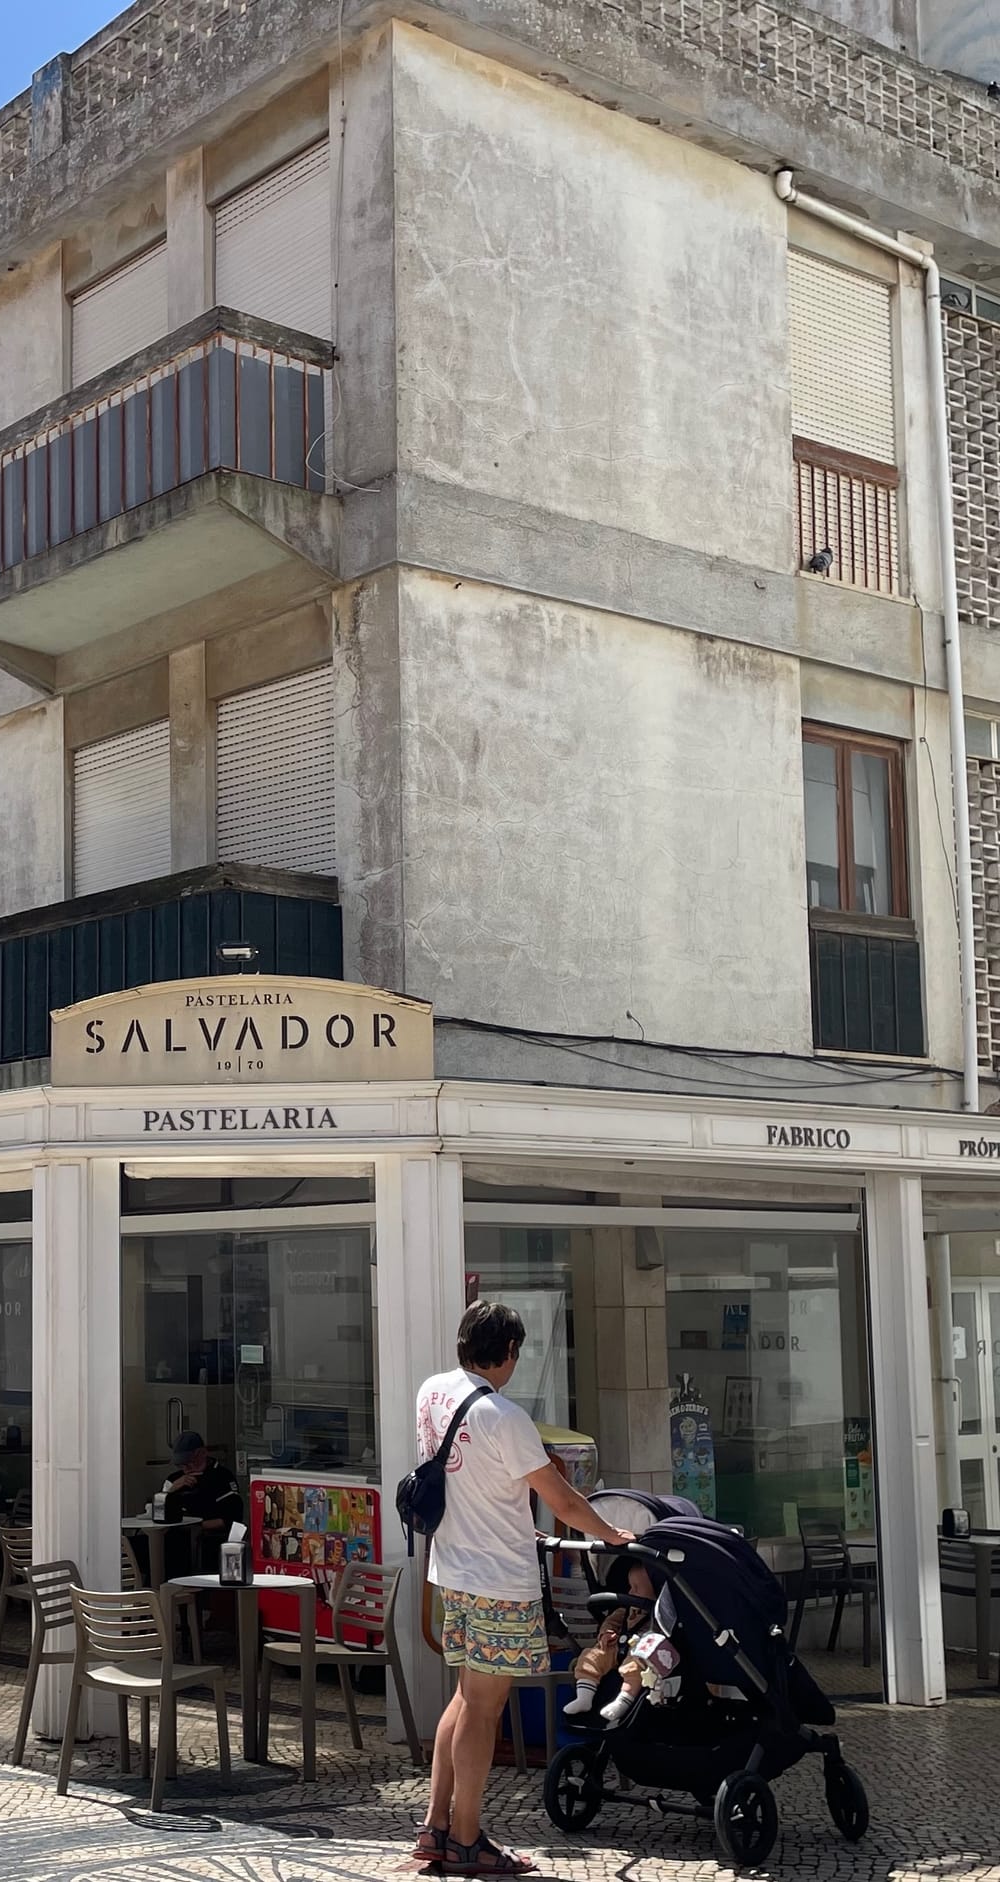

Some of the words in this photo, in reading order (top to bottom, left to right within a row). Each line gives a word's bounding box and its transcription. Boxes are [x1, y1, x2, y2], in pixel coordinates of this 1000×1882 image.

[185, 993, 293, 1007] PASTELARIA
[85, 1013, 397, 1054] SALVADOR
[143, 1107, 338, 1131] PASTELARIA
[766, 1124, 851, 1149] FABRICO
